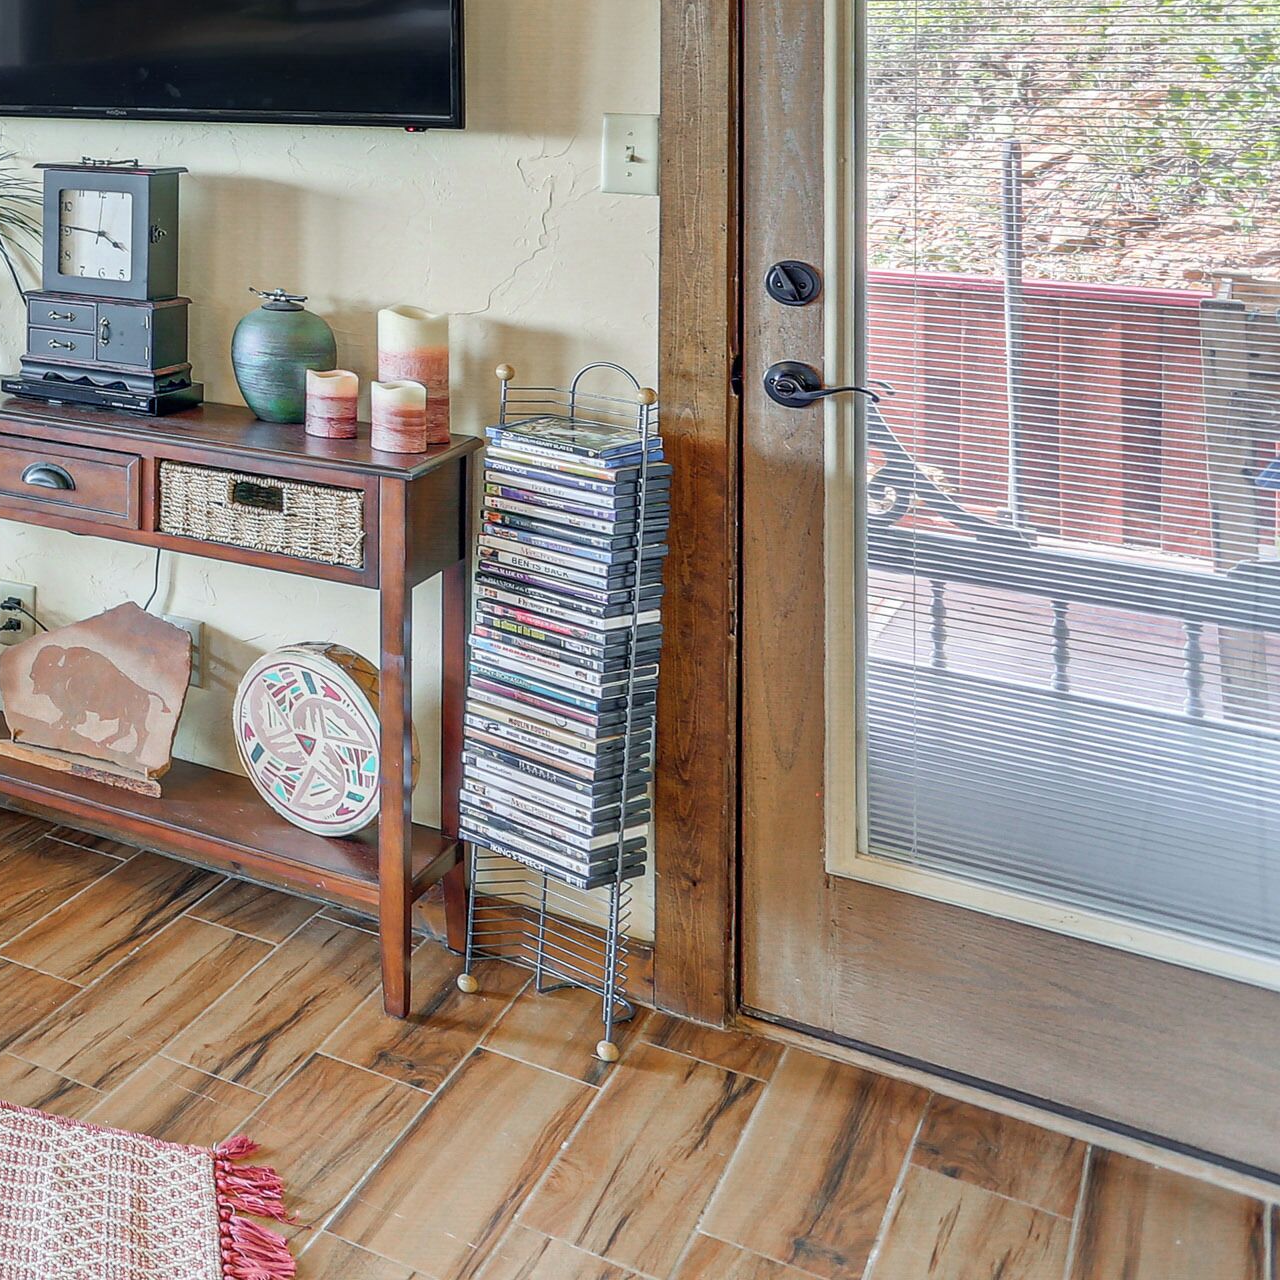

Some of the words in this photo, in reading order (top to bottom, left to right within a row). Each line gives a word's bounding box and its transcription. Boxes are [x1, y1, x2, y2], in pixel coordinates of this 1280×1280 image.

[63, 200, 73, 212] 10
[64, 250, 71, 261] 8
[79, 265, 85, 276] 7
[98, 267, 105, 278] 6
[119, 269, 125, 279] 5
[511, 556, 529, 568] BEN
[508, 718, 529, 730] MOULIN
[518, 855, 545, 872] SPEECH
